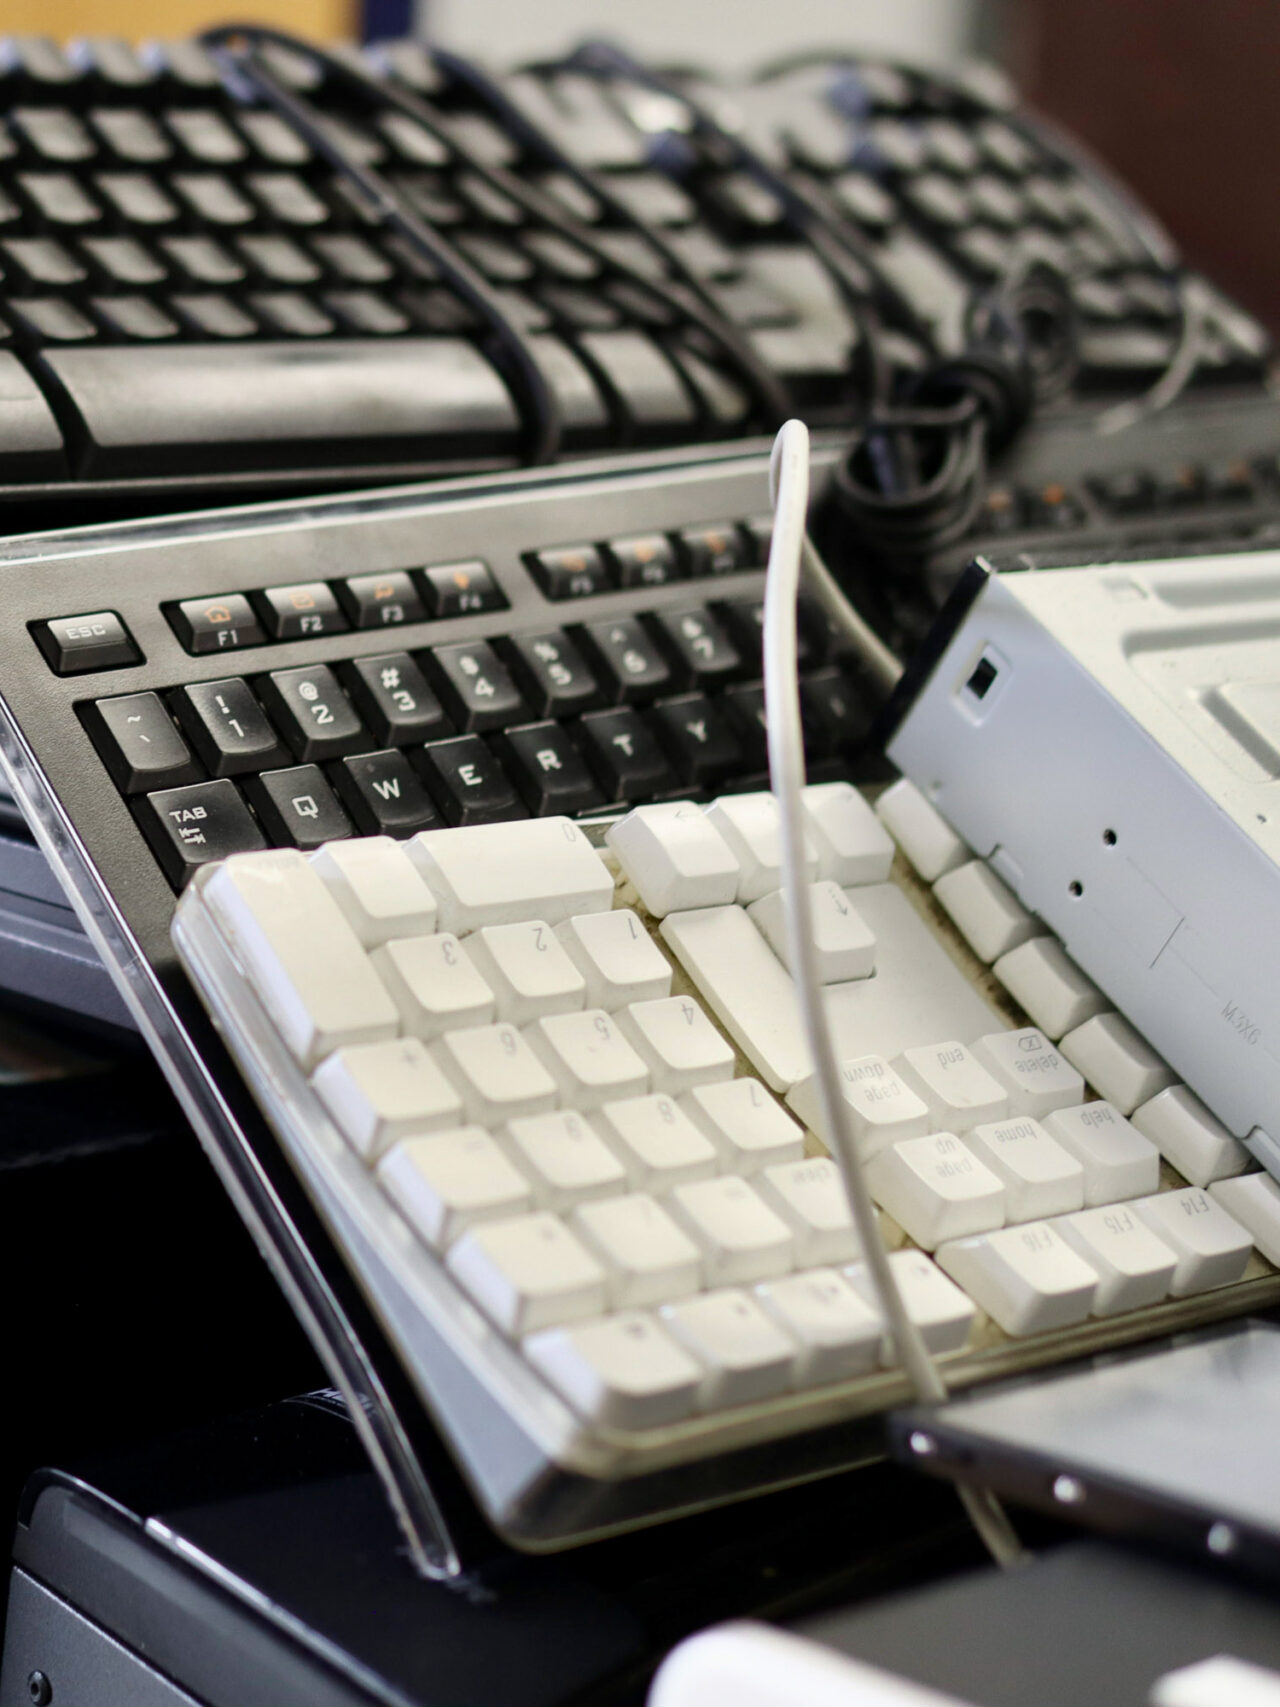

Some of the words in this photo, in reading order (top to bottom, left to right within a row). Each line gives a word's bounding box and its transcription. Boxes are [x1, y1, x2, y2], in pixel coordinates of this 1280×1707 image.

[300, 616, 323, 633] F2
[381, 605, 405, 623] F3
[65, 624, 107, 640] ESC
[218, 630, 238, 646] F1
[475, 677, 495, 697] 4
[392, 690, 416, 712] 3
[311, 704, 334, 724] 2
[229, 719, 244, 737] 1
[686, 720, 707, 742] Y
[613, 733, 633, 756] T
[536, 749, 562, 771] R
[458, 764, 482, 785] E
[372, 778, 401, 799] W
[169, 806, 208, 823] TAB
[292, 795, 319, 818] Q
[532, 927, 548, 951] 2
[441, 940, 457, 966] 3
[681, 1003, 695, 1026] 4
[1221, 1000, 1262, 1046] M3X6
[937, 1047, 966, 1070] end
[1015, 1053, 1060, 1074] delete
[843, 1062, 884, 1084] down
[864, 1080, 899, 1103] page
[1080, 1101, 1116, 1128] help
[993, 1123, 1038, 1144] home
[936, 1135, 956, 1155] up
[935, 1157, 973, 1179] page
[1180, 1194, 1210, 1216] F14
[1104, 1212, 1135, 1235] F15
